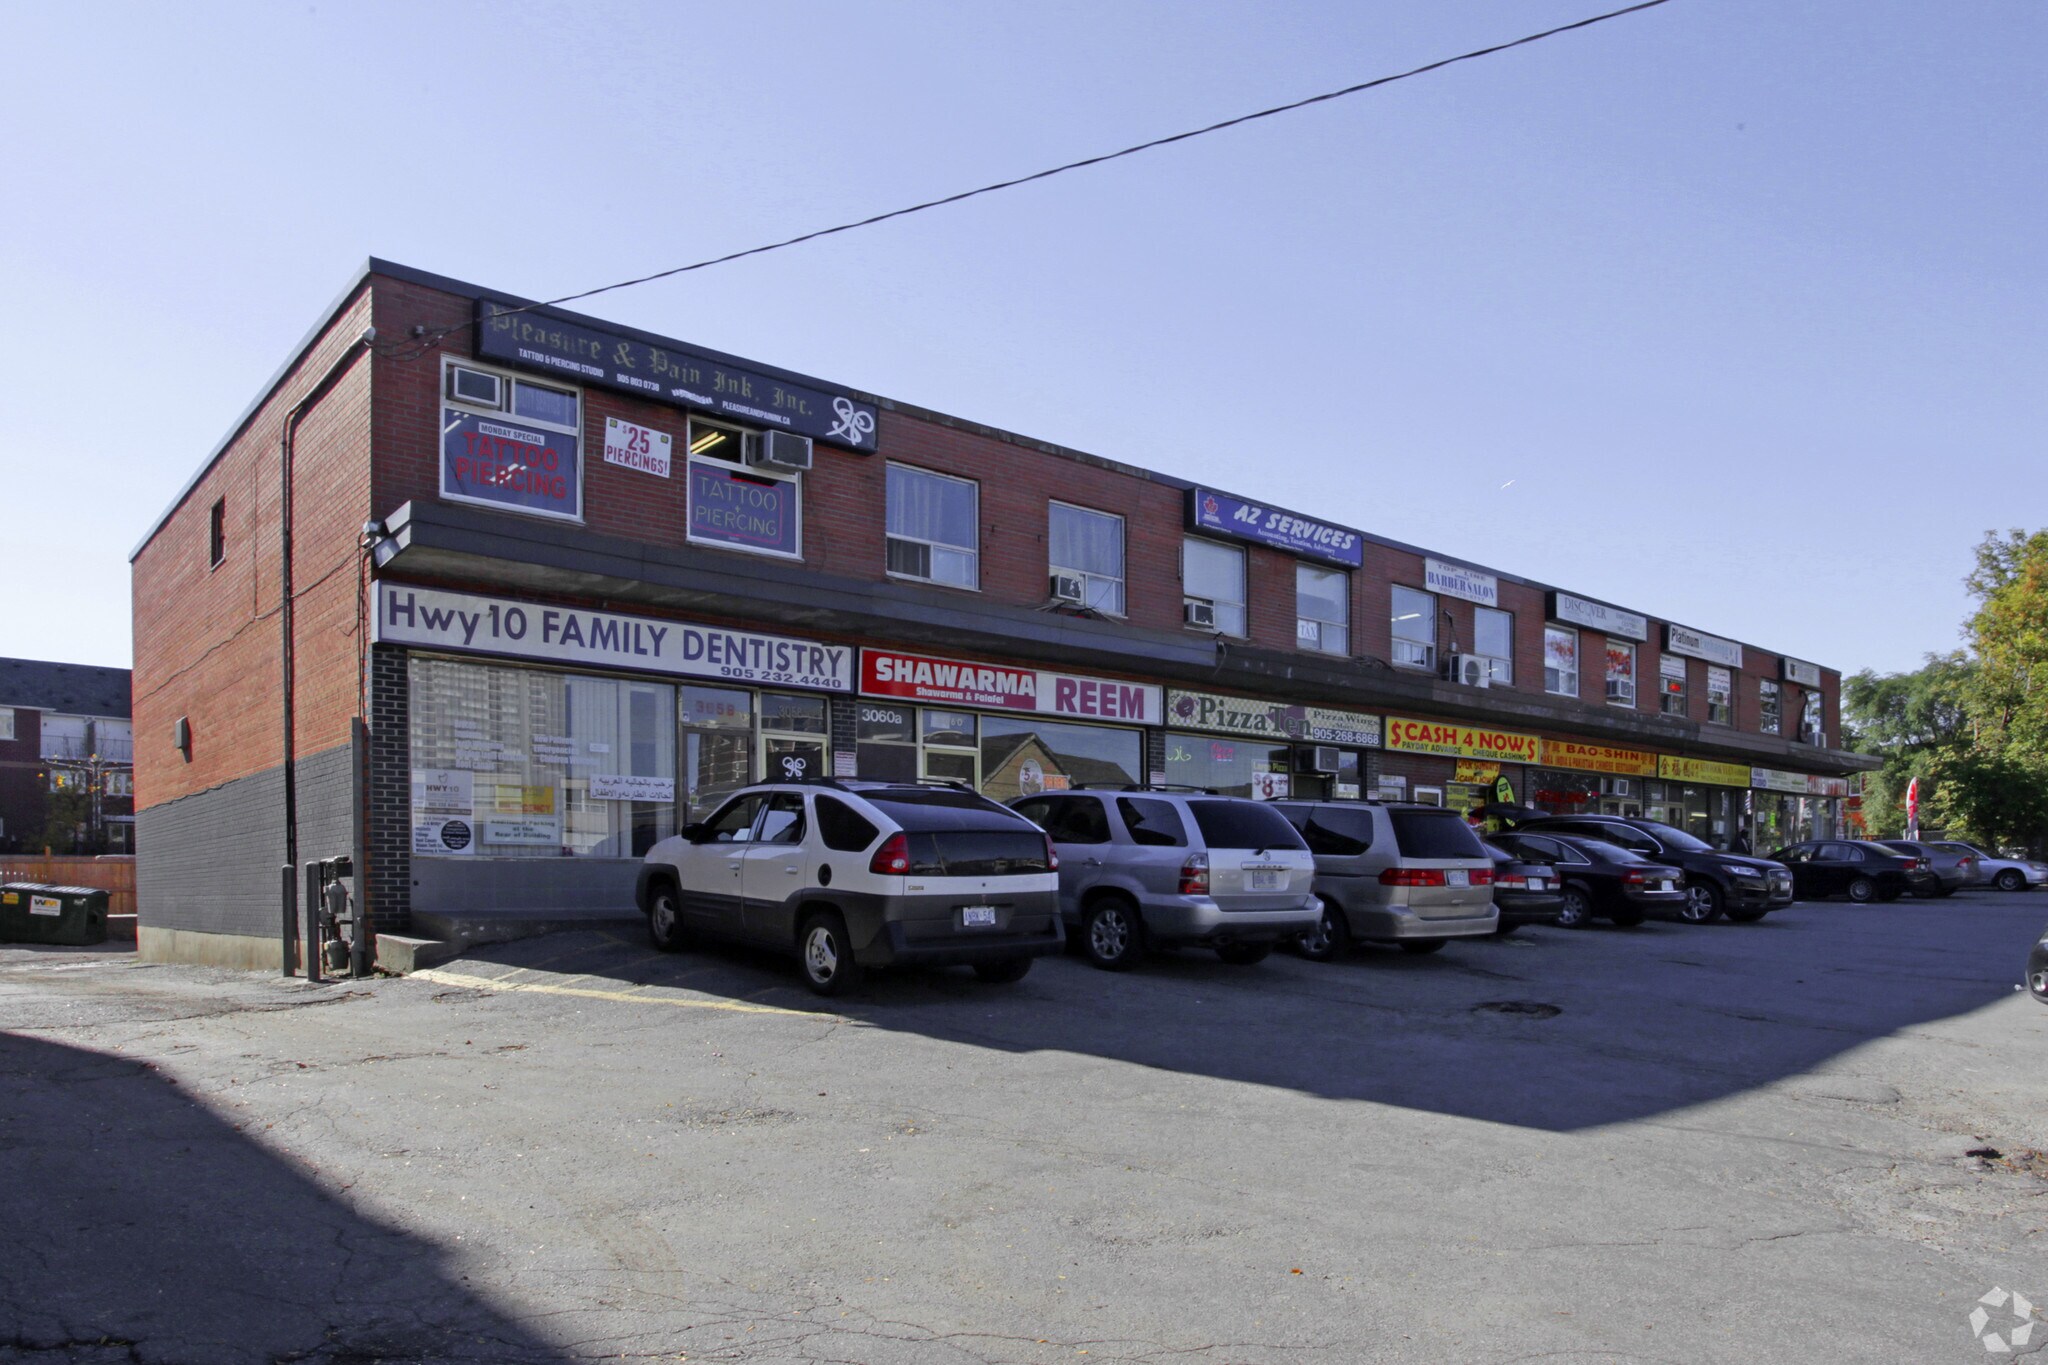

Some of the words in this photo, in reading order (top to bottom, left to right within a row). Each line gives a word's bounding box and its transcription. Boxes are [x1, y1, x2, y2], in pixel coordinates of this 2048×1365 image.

[489, 303, 601, 359] Pleasure
[613, 342, 635, 368] &
[649, 348, 700, 384] Pain
[772, 387, 813, 416] Inc.
[519, 348, 544, 363] TATTOO
[551, 357, 581, 372] PIERCING
[581, 364, 604, 378] STUDIO
[481, 424, 511, 438] MONDAY
[513, 430, 542, 444] SPECIAL
[463, 432, 558, 471] TATTOO
[607, 445, 668, 475] PIERCINGS!
[456, 456, 566, 500] PIERCING
[699, 477, 777, 512] TATTOO
[695, 505, 776, 536] PIERCING
[1234, 504, 1261, 525] AZ
[1265, 513, 1355, 549] SERVICES
[1438, 564, 1457, 572] TOP
[1428, 571, 1466, 592] BARBER
[1467, 582, 1494, 600] SALON
[543, 609, 668, 658] FAMILY
[683, 628, 844, 679] DENTISTRY
[720, 665, 755, 680] 905
[761, 670, 842, 689] 232.4440
[876, 656, 1036, 697] SHAWARMA
[1055, 677, 1145, 720] REEM
[916, 686, 963, 701] Shawarma
[965, 693, 972, 701] &
[975, 693, 1004, 704] Falafel
[861, 708, 902, 724] 3060a
[1198, 696, 1268, 734] Pizza
[1269, 705, 1313, 736] Ten
[1313, 710, 1343, 721] Pizza
[1345, 714, 1378, 726] Wings
[1313, 727, 1379, 745] 905-268-6868
[1463, 731, 1473, 747] 4
[1402, 741, 1428, 751] PAYDAY
[1473, 749, 1498, 759] CHEQUE
[1500, 751, 1526, 761] CASHING
[1566, 744, 1639, 760] BAO-SHIN
